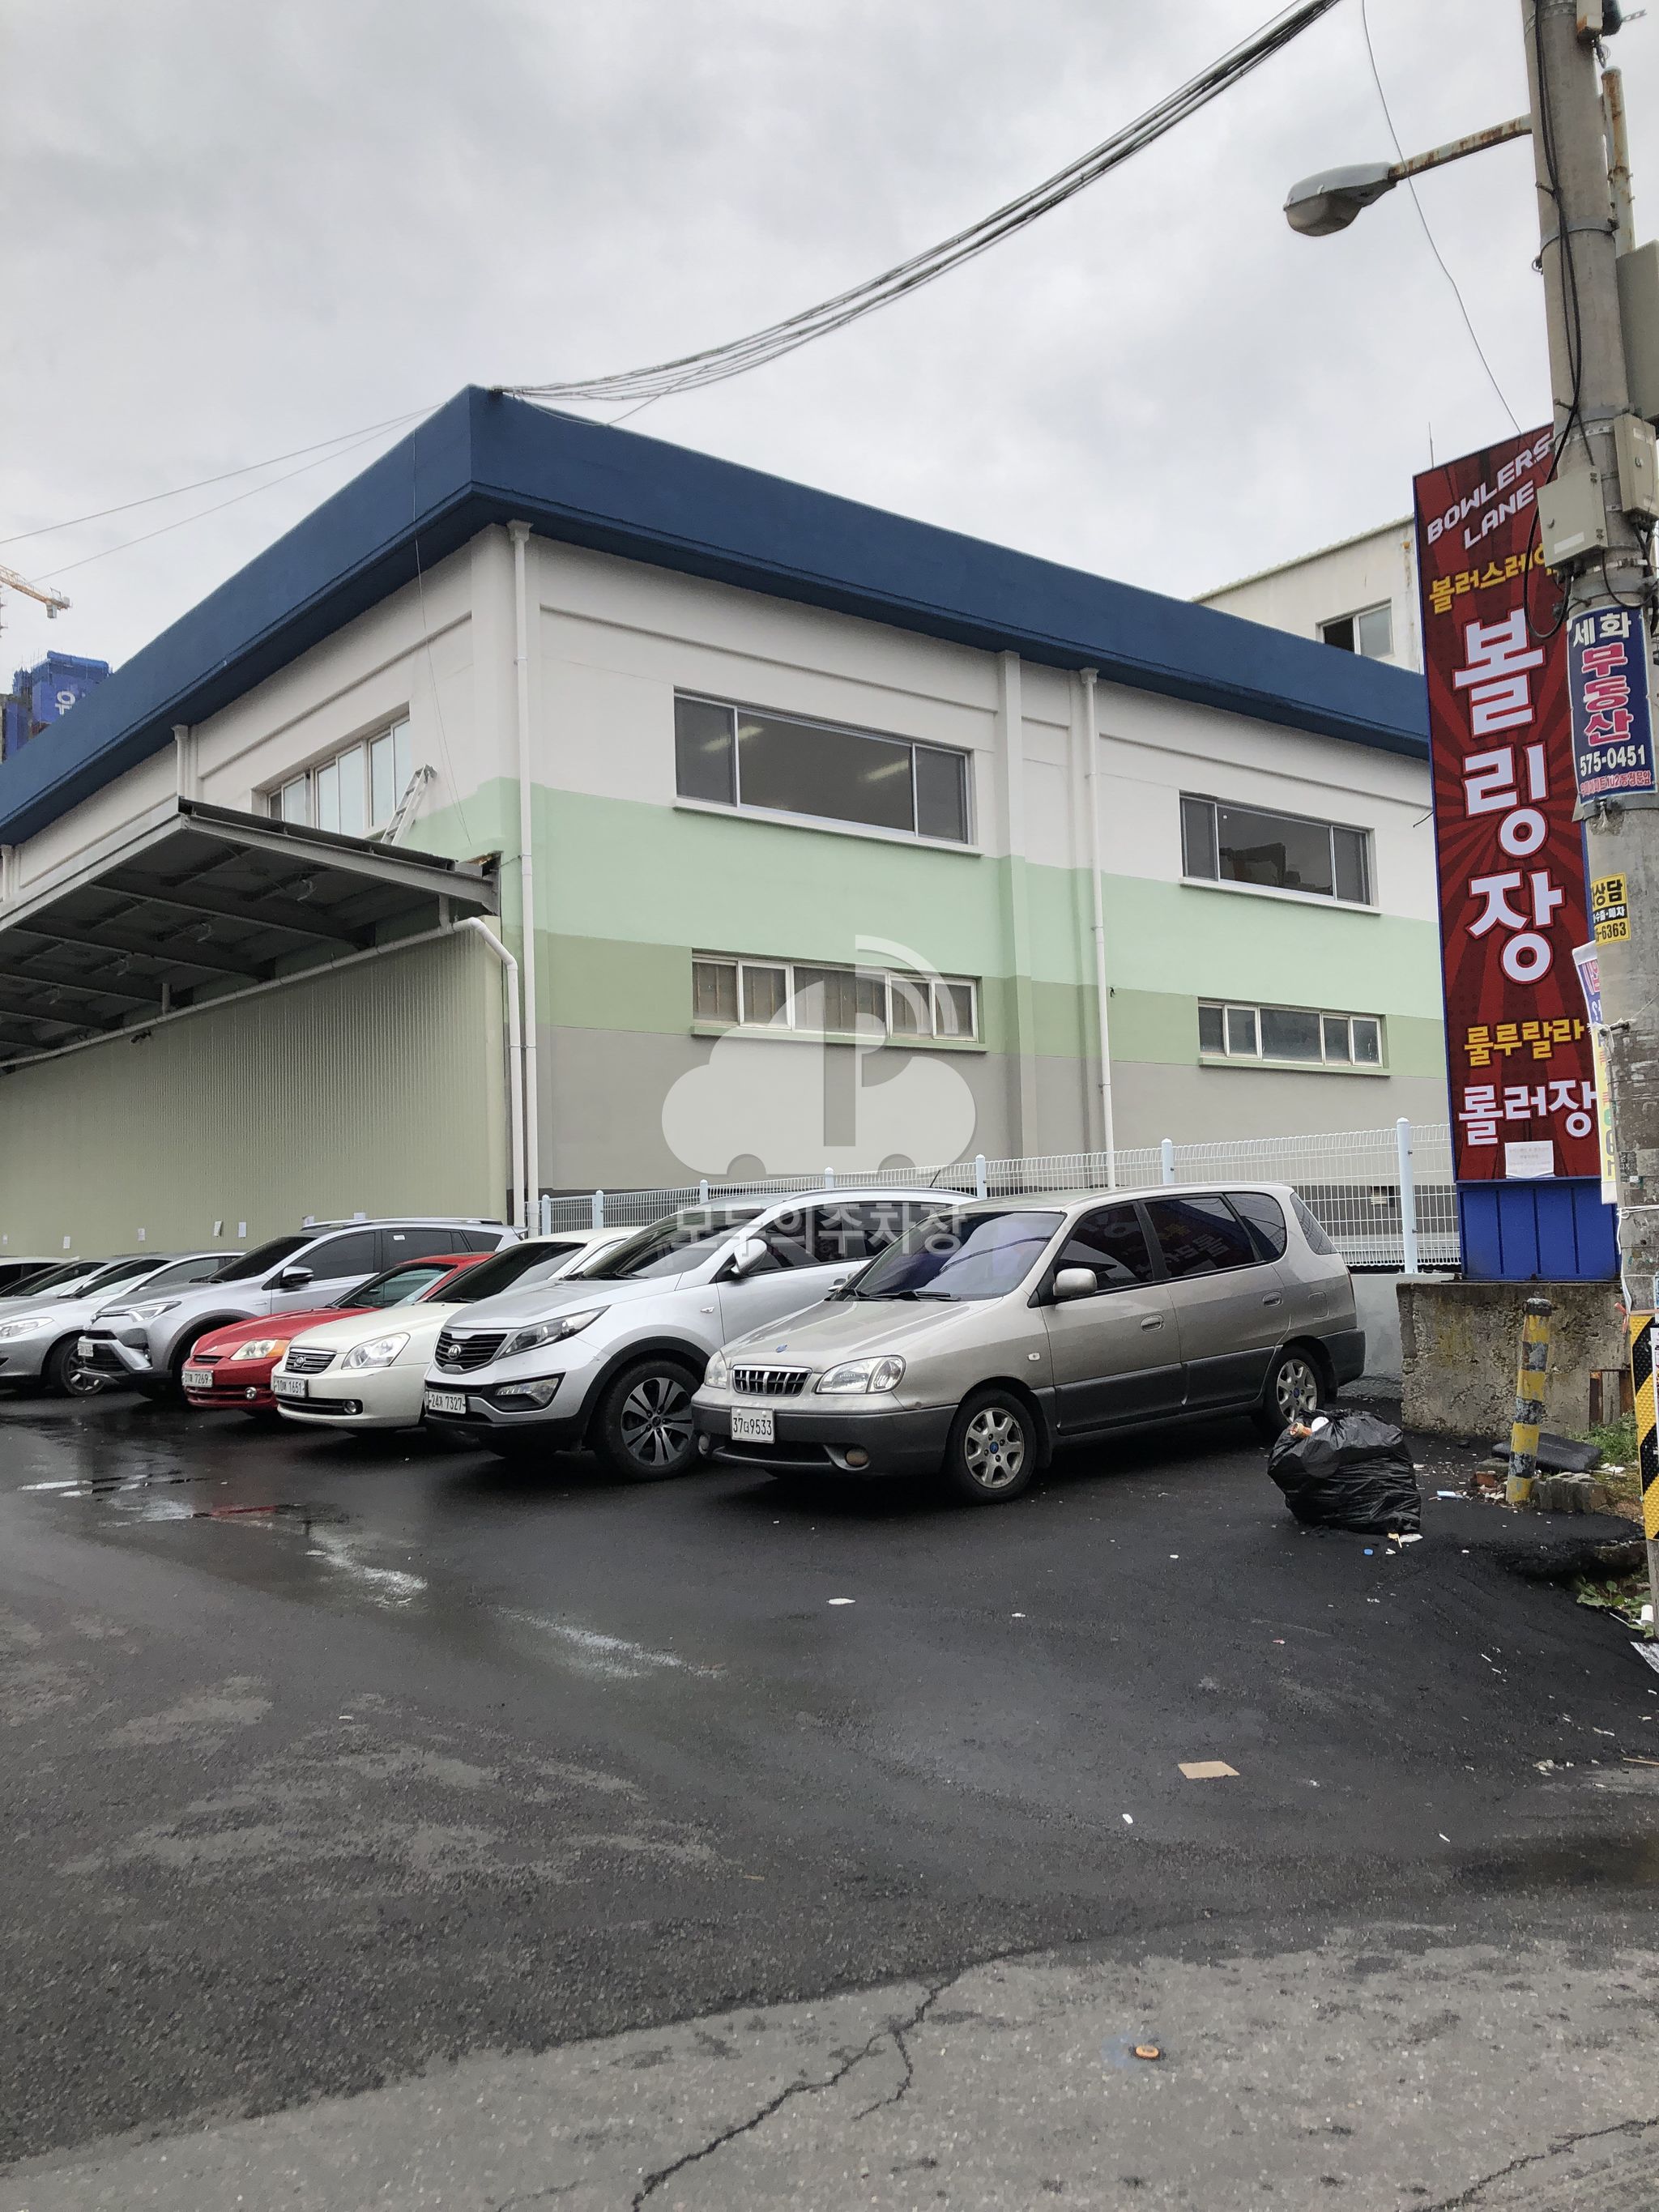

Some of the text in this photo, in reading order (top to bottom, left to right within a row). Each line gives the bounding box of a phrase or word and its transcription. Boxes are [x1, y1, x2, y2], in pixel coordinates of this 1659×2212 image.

[1427, 433, 1551, 545] BOWLERS
[1464, 479, 1535, 549] LANE
[1573, 612, 1631, 647] 세화
[1581, 641, 1634, 746] 부동산
[1580, 744, 1646, 777] 575-0451
[1452, 607, 1565, 983] 볼링장
[1592, 879, 1623, 906] 상담
[1464, 1019, 1584, 1067] 룰루랄라
[1458, 1080, 1597, 1145] 롤러장
